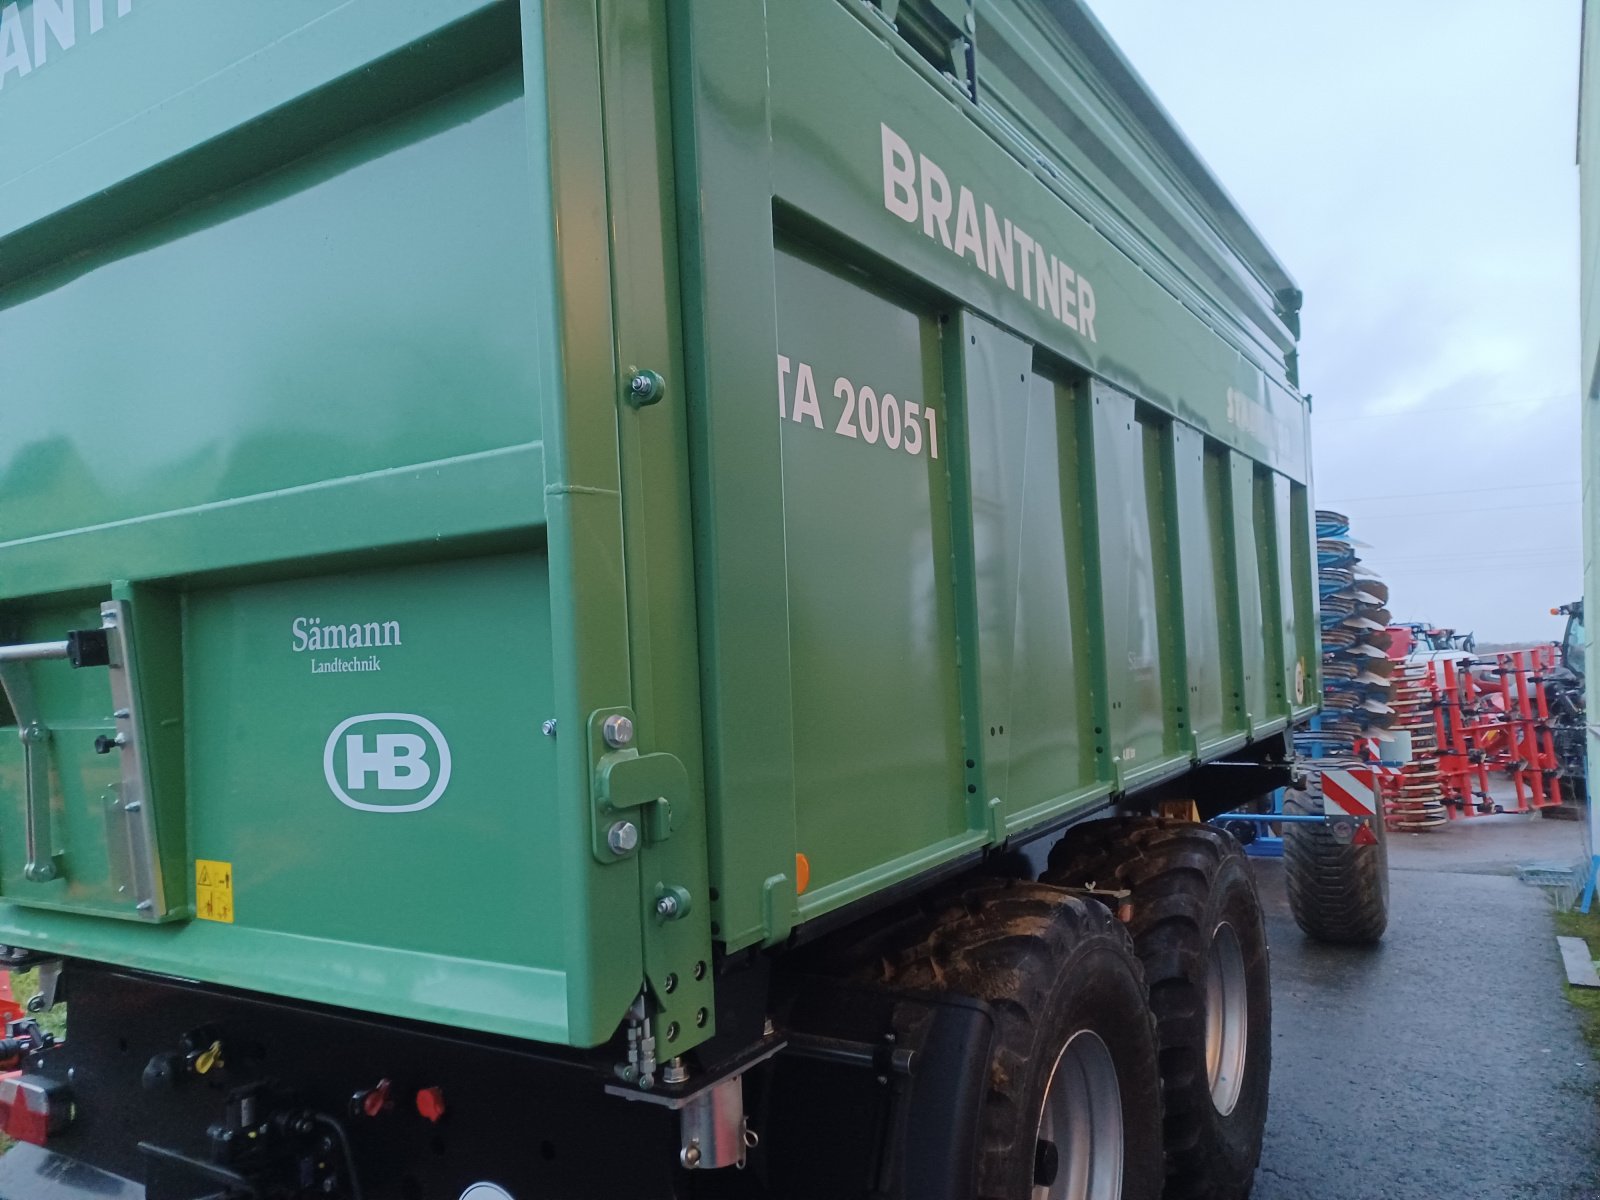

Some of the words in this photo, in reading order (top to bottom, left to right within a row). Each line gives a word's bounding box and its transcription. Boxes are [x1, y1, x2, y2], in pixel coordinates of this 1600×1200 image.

[880, 121, 1097, 343] BRANTNER
[777, 354, 824, 430] TA
[833, 377, 938, 459] 20051
[292, 617, 402, 651] Sämann
[311, 655, 381, 673] Landtechnik
[346, 733, 431, 790] HB
